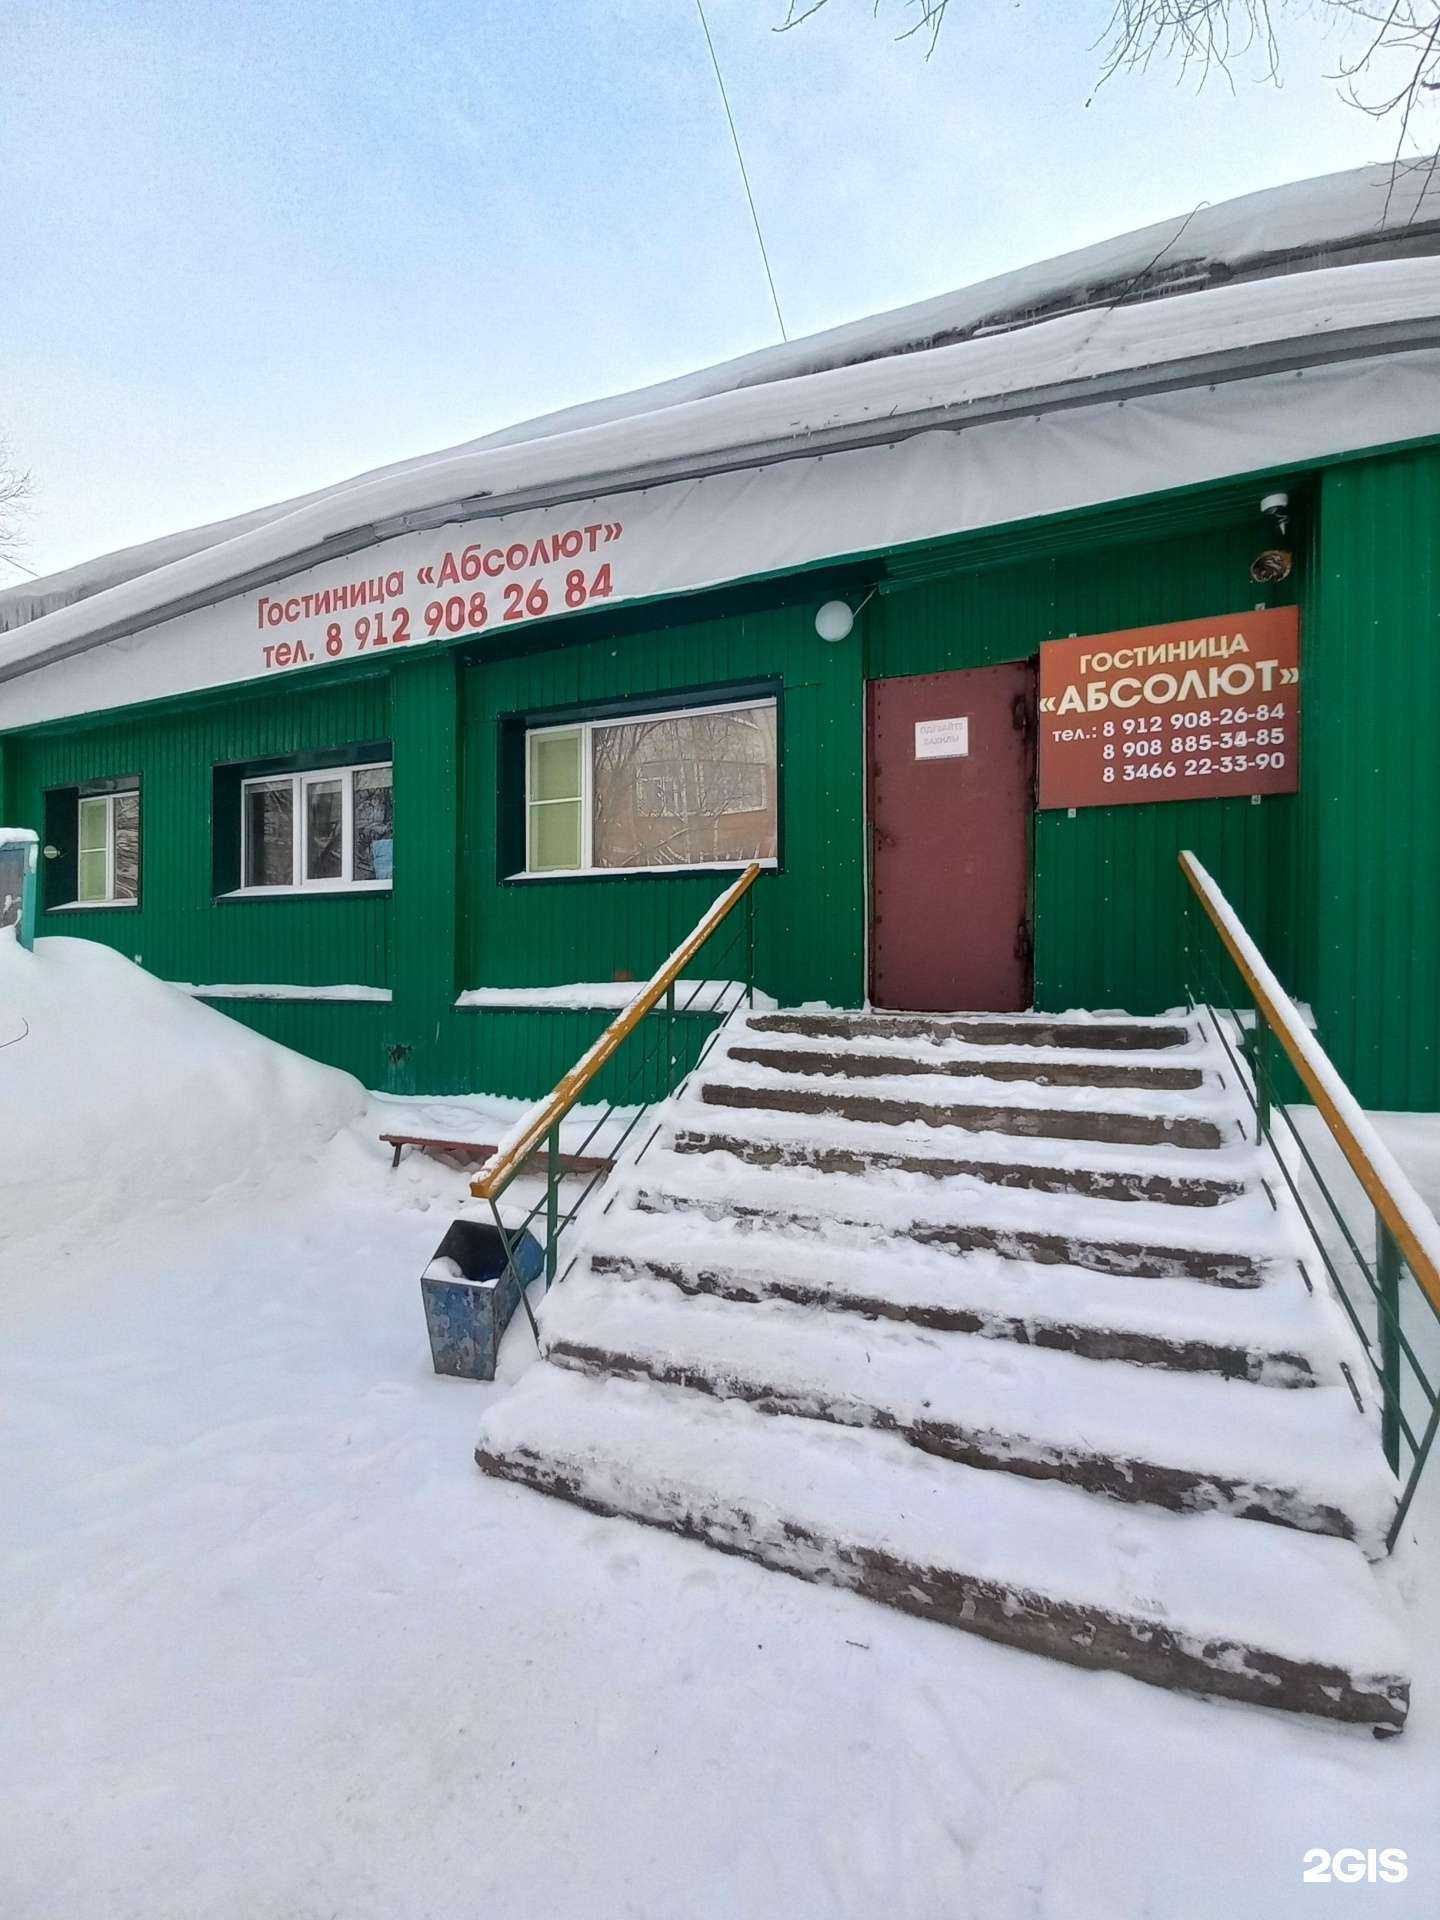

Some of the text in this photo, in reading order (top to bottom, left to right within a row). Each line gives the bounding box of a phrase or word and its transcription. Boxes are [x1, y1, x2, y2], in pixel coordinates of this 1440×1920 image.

[257, 521, 624, 630] Гостиница «Абсолют»
[263, 563, 614, 669] тел. 8 912 908 26 84
[1079, 633, 1251, 674] ГОСТИНИЦА
[1039, 659, 1299, 716] «АБСОЛЮТ»
[1052, 703, 1286, 743] тел.: 8 912 908-26-84
[1103, 743, 1115, 760] 8
[1122, 739, 1163, 758] 908
[1103, 752, 1286, 783] 8 3466 22-33-90
